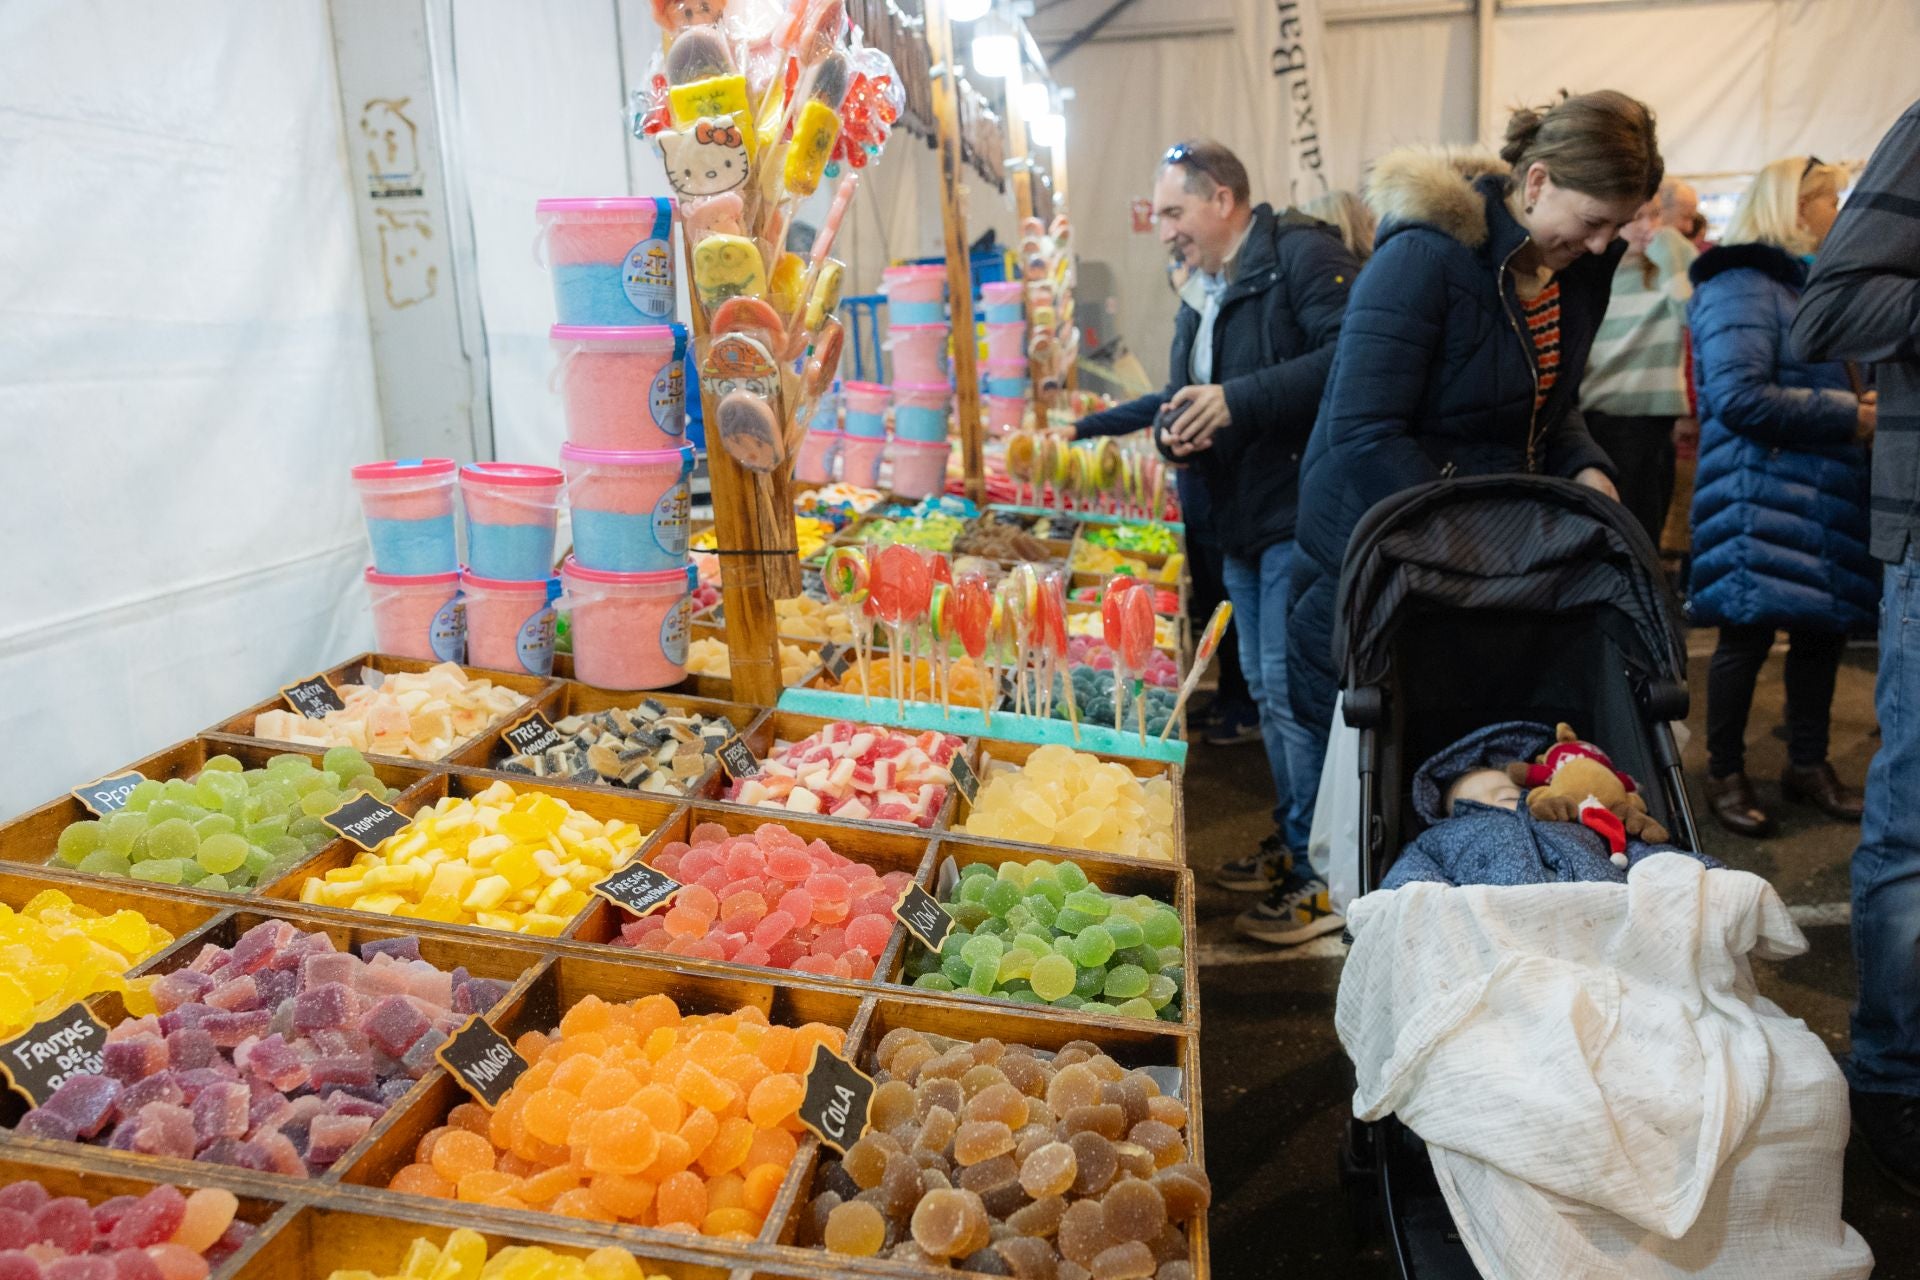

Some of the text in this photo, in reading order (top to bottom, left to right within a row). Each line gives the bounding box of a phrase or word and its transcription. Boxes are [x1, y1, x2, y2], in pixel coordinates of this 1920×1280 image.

[288, 683, 325, 703] TARTA
[510, 720, 543, 744] TRES
[94, 783, 137, 810] PER
[343, 808, 394, 836] TROPICAL
[605, 871, 651, 896] FRESAS
[631, 880, 652, 895] CON
[908, 899, 940, 938] KIWI
[12, 1019, 95, 1071] FRUTAS
[56, 1045, 92, 1070] DEL
[463, 1043, 513, 1091] MANGO
[821, 1084, 856, 1138] COLA
